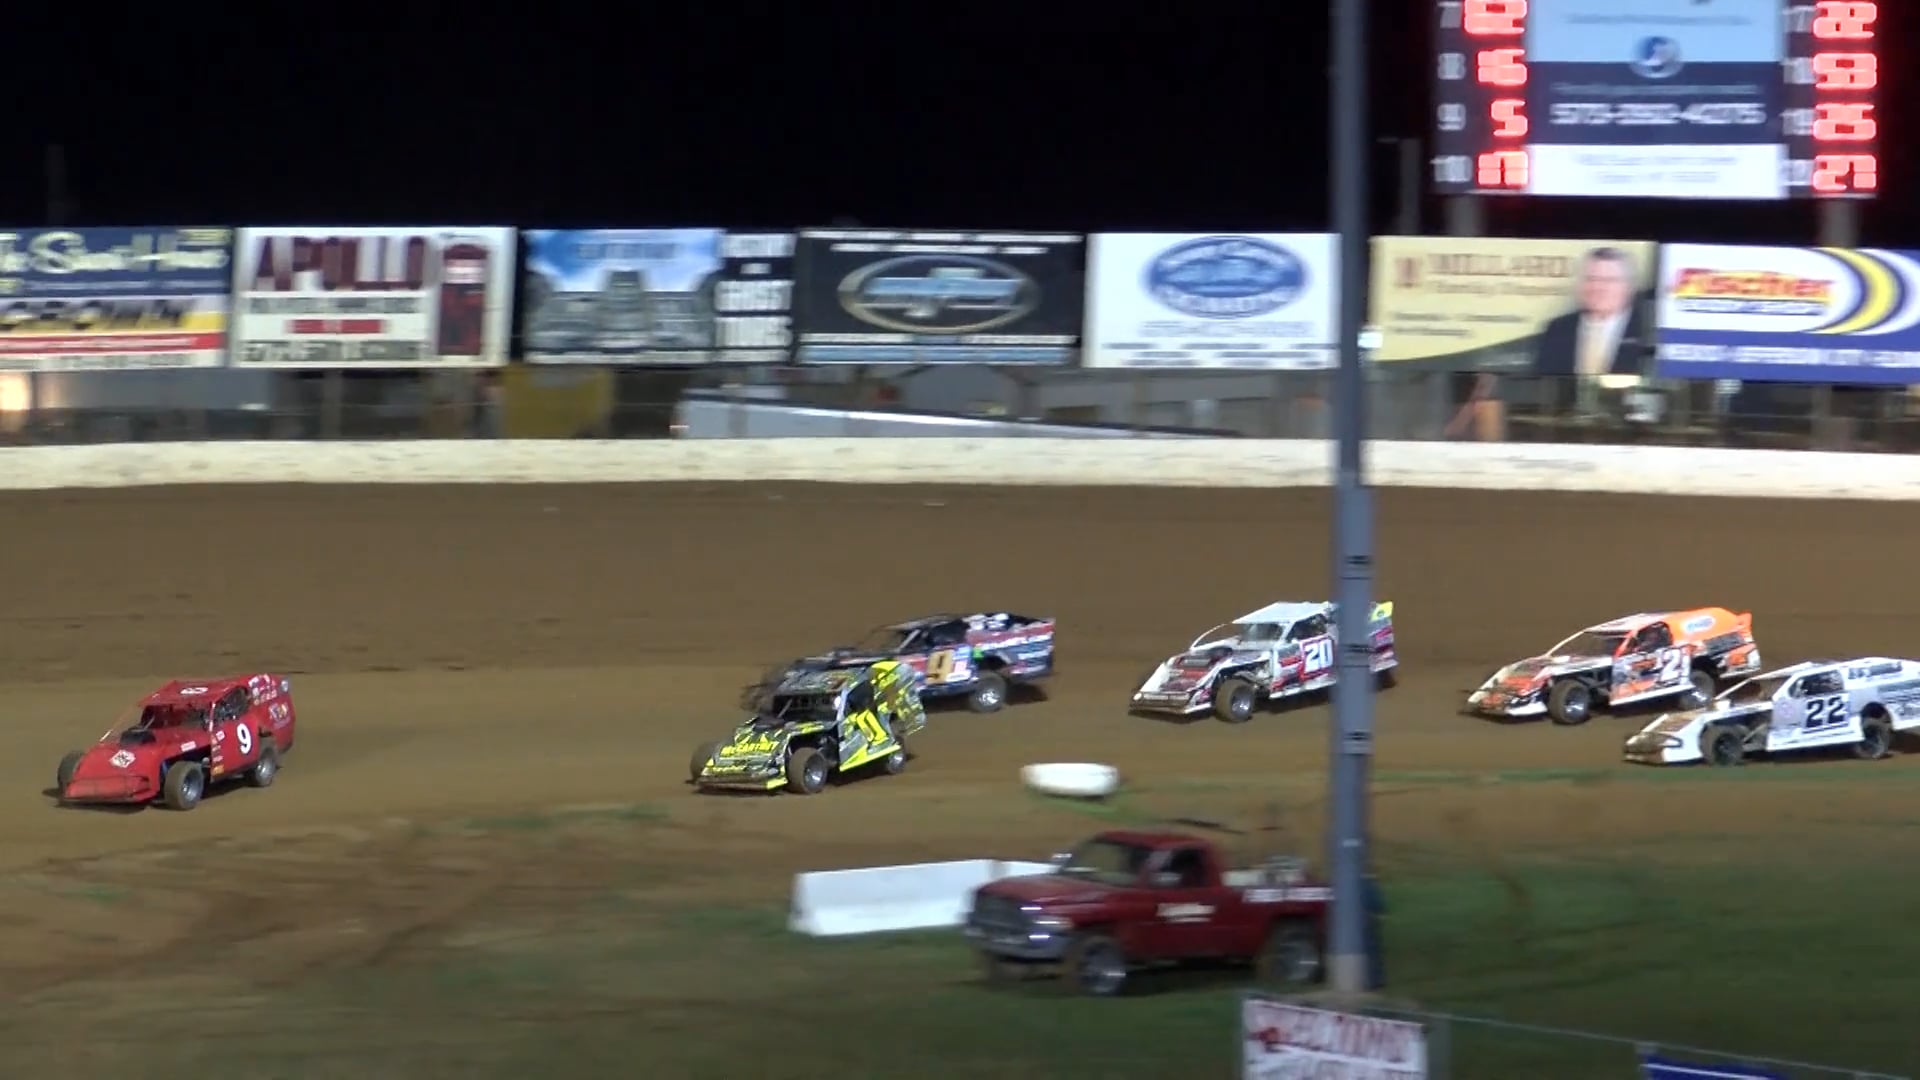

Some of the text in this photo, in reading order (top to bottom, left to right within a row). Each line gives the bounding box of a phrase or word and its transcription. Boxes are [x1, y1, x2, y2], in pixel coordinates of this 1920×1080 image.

[1438, 104, 1466, 130] 9
[1490, 99, 1528, 137] 5
[1430, 155, 1472, 182] 10
[253, 235, 428, 291] APOLLO
[1675, 267, 1832, 300] Fischer
[1304, 639, 1333, 672] 20
[1806, 695, 1846, 728] 22
[236, 723, 252, 754] 9
